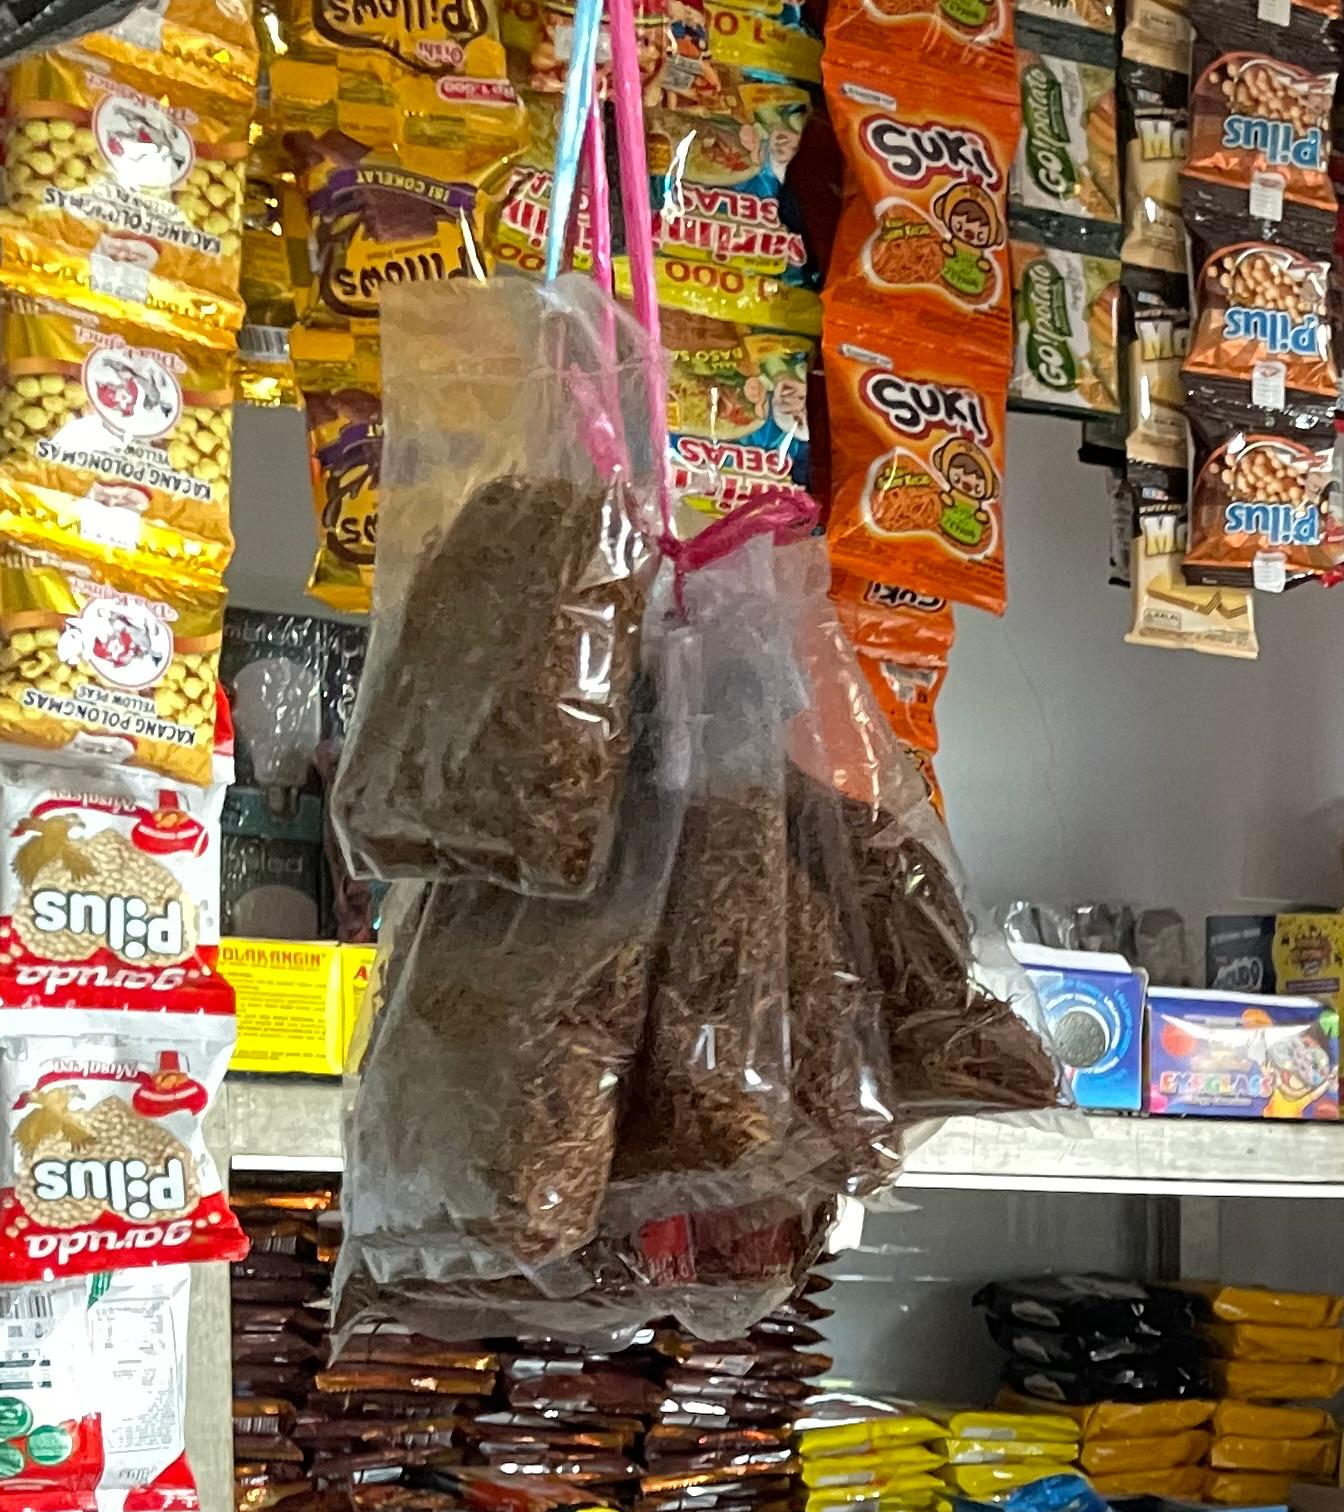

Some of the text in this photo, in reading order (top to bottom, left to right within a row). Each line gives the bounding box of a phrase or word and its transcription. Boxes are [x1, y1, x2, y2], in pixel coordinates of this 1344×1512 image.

[868, 119, 997, 182] SUKI
[1222, 115, 1321, 169] Pilus
[1223, 305, 1319, 358] Pilus
[869, 374, 988, 439] SUKI
[1224, 501, 1320, 545] Pilus
[32, 889, 182, 962] Pilus
[31, 1157, 185, 1219] Pilus
[24, 1220, 194, 1265] garuda
